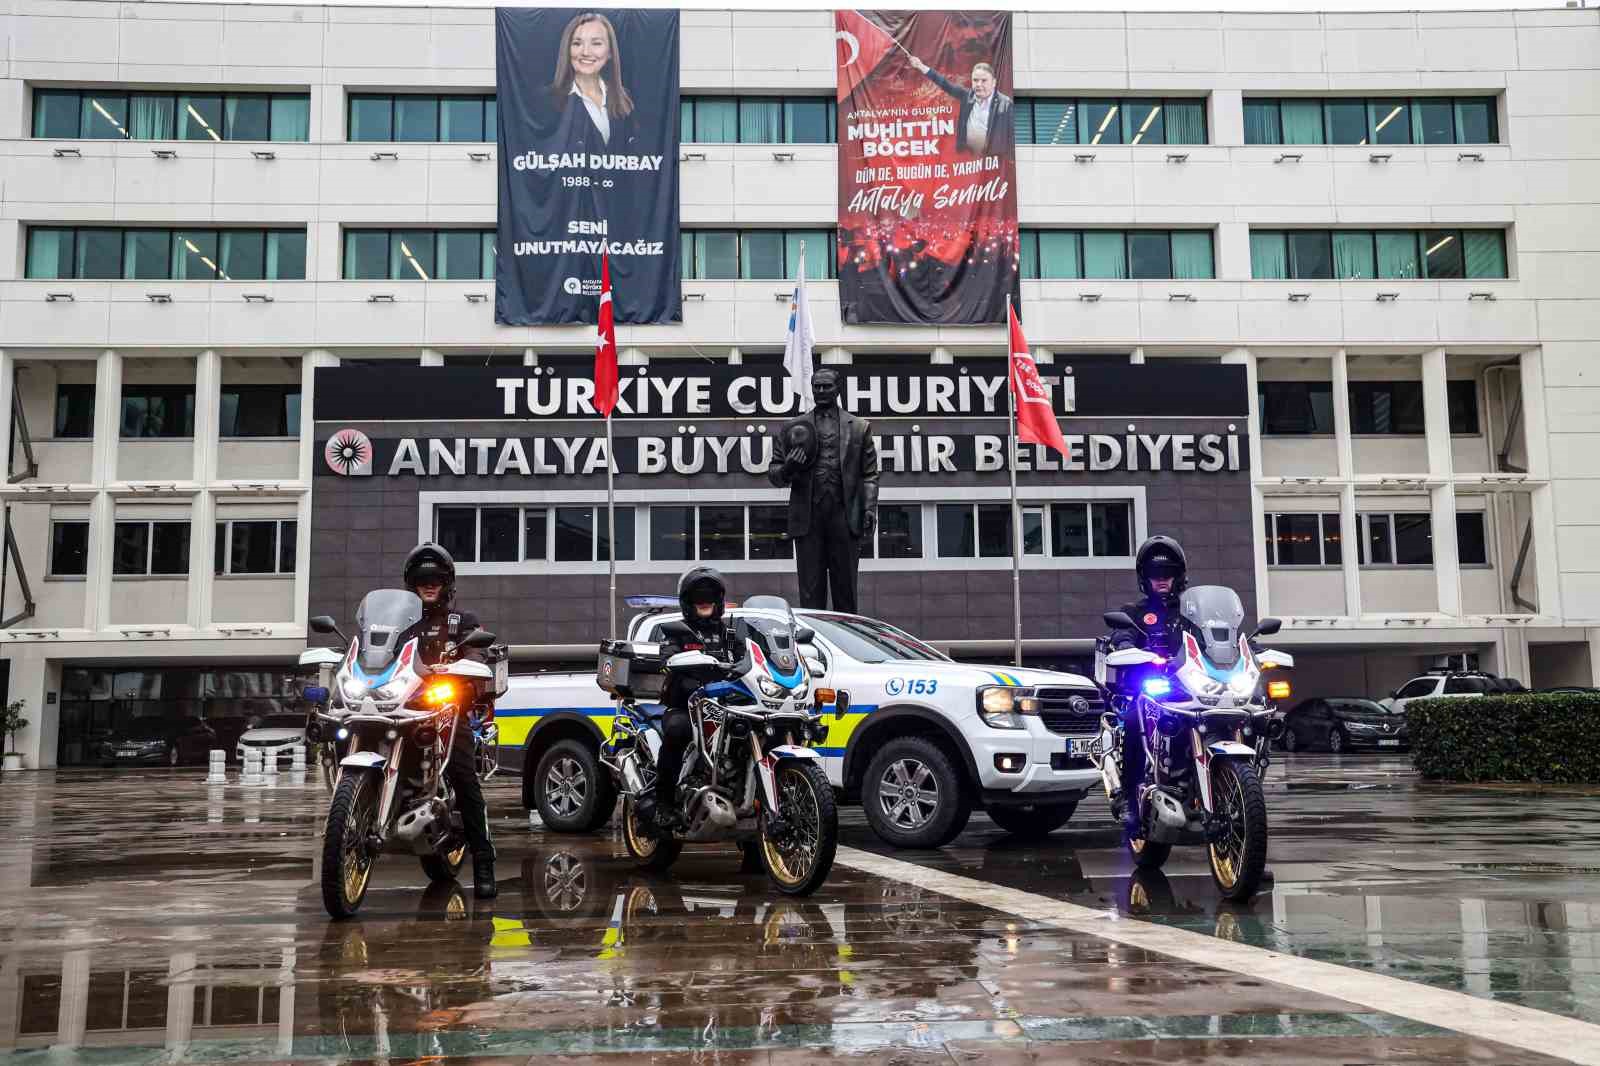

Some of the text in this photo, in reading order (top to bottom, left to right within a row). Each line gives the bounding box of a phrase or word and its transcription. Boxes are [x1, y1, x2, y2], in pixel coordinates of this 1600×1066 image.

[911, 106, 953, 116] GURURU
[847, 116, 955, 141] MUHİTTİN
[863, 138, 940, 158] BÖCEK
[513, 151, 663, 171] GÜLŞAH DURBAY
[855, 167, 875, 184] DÜN
[896, 163, 932, 180] BUGÜN
[952, 158, 983, 176] YARIN
[985, 156, 999, 171] DA
[561, 176, 591, 187] 1988
[847, 177, 1009, 216] Antalya Seninle
[567, 219, 608, 235] SENİ
[513, 240, 664, 256] UNUTMAYACAĞIZ
[495, 366, 711, 415] TÜRKİYE
[387, 422, 1240, 477] ANTALYA BÜYÜHİR BELEDİYESİ
[906, 679, 938, 695] 153
